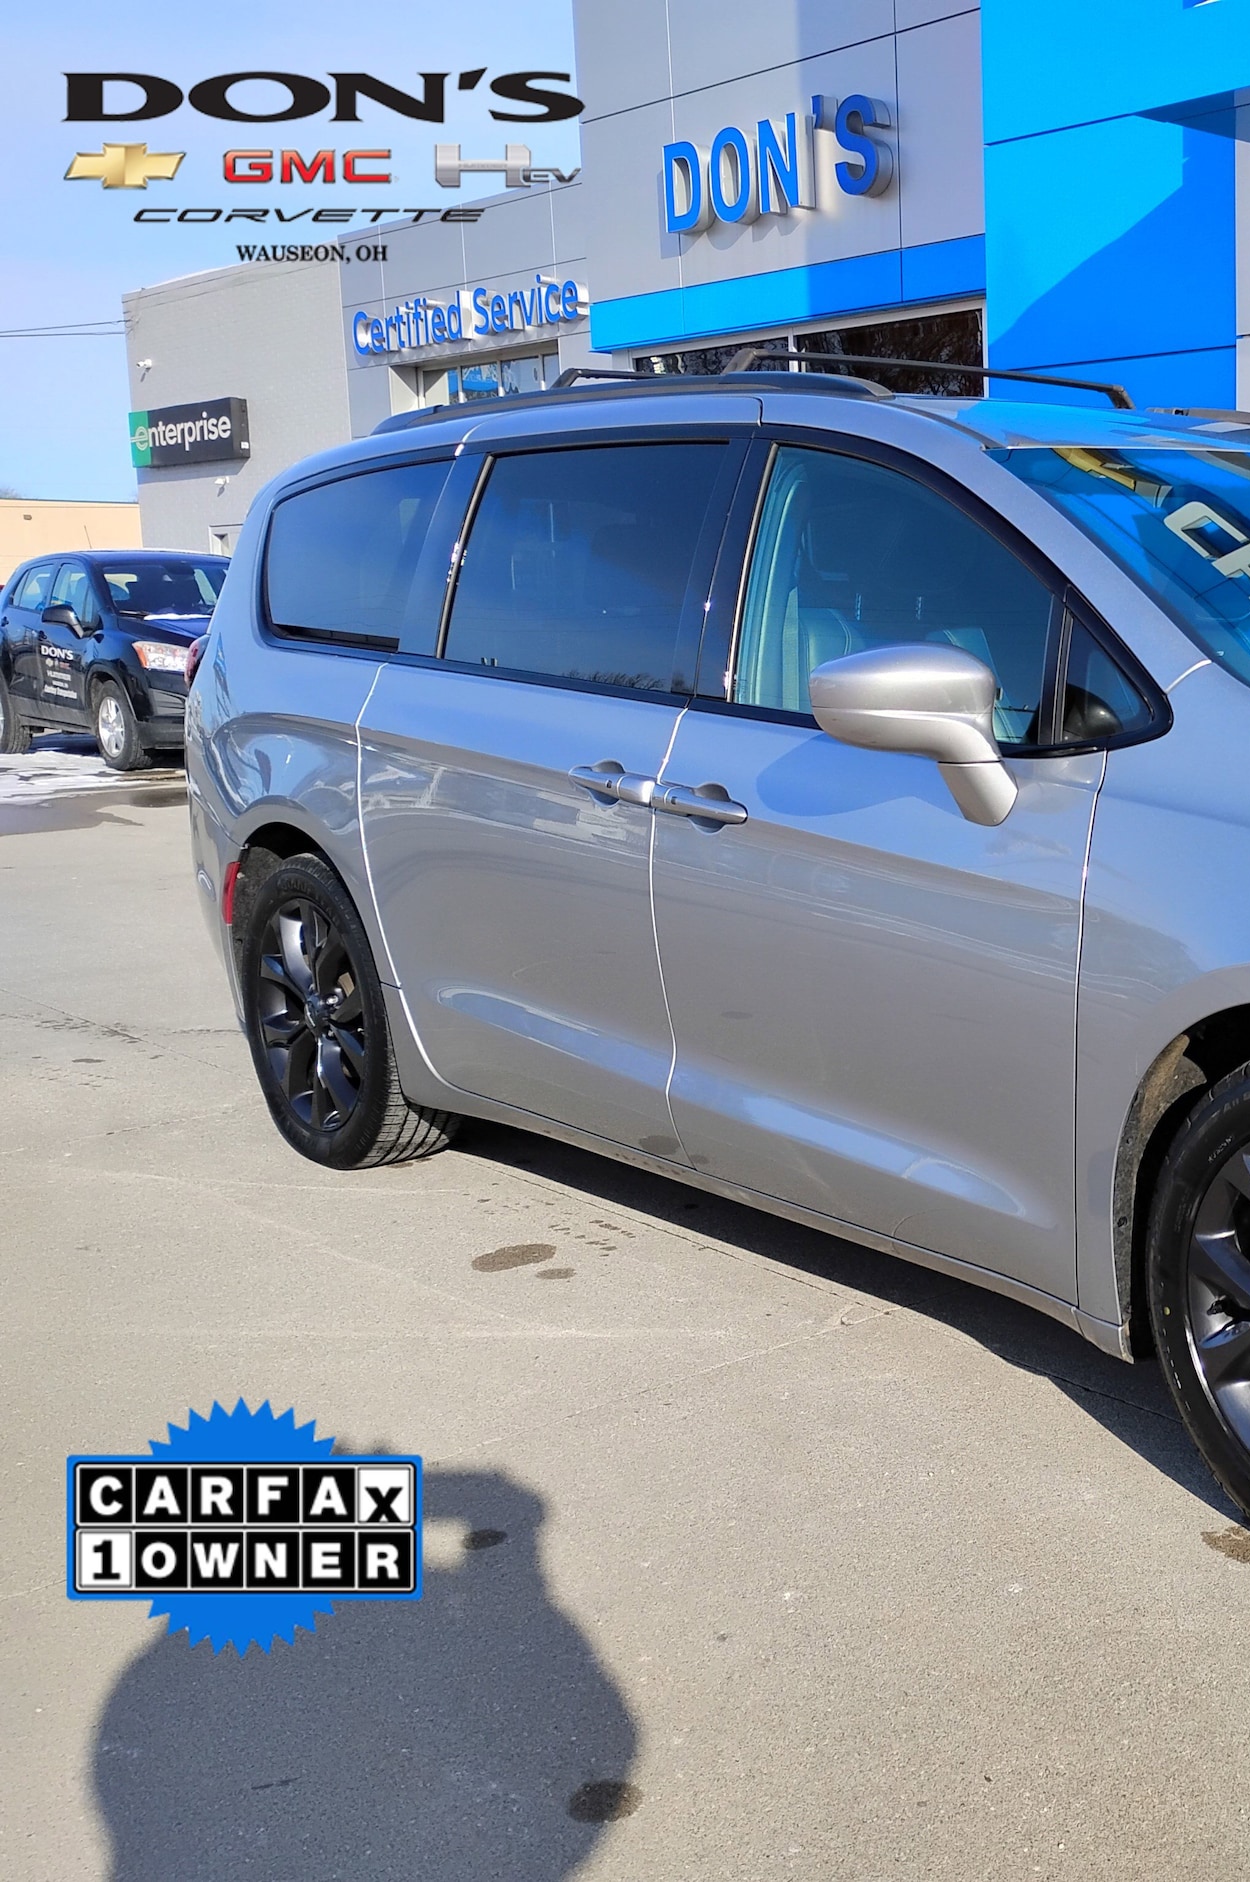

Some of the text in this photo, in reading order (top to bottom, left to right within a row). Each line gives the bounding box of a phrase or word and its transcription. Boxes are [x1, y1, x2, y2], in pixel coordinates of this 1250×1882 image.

[662, 94, 891, 234] DON'S
[352, 272, 579, 357] Certified Service
[130, 411, 232, 451] enterprise
[41, 645, 74, 660] DON'S
